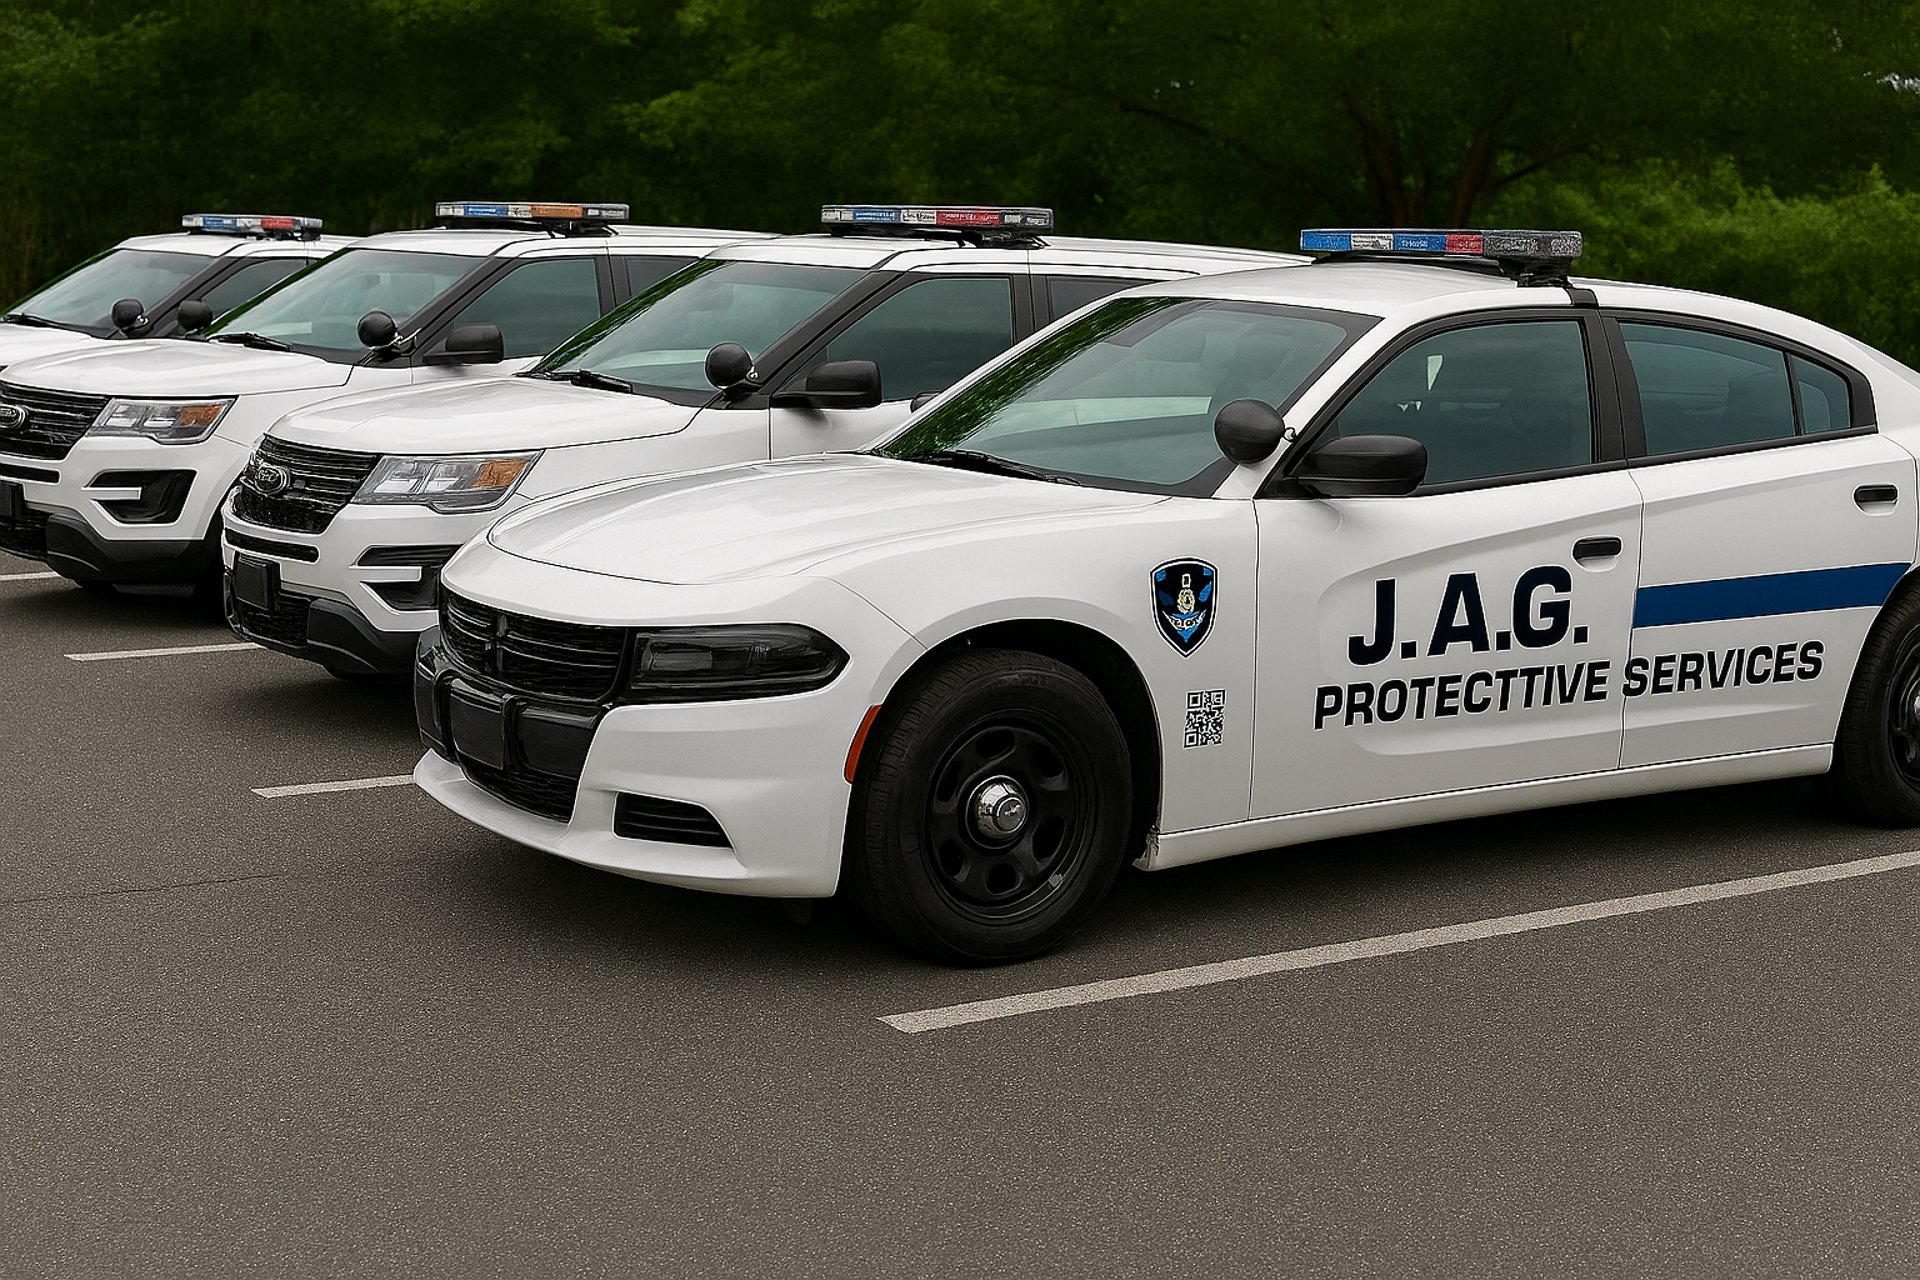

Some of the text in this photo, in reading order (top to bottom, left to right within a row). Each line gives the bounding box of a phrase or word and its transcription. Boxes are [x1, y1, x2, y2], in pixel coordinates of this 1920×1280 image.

[1348, 566, 1589, 665] J.A.G.
[1315, 640, 1825, 730] PROTECTTIVE SERVICES
